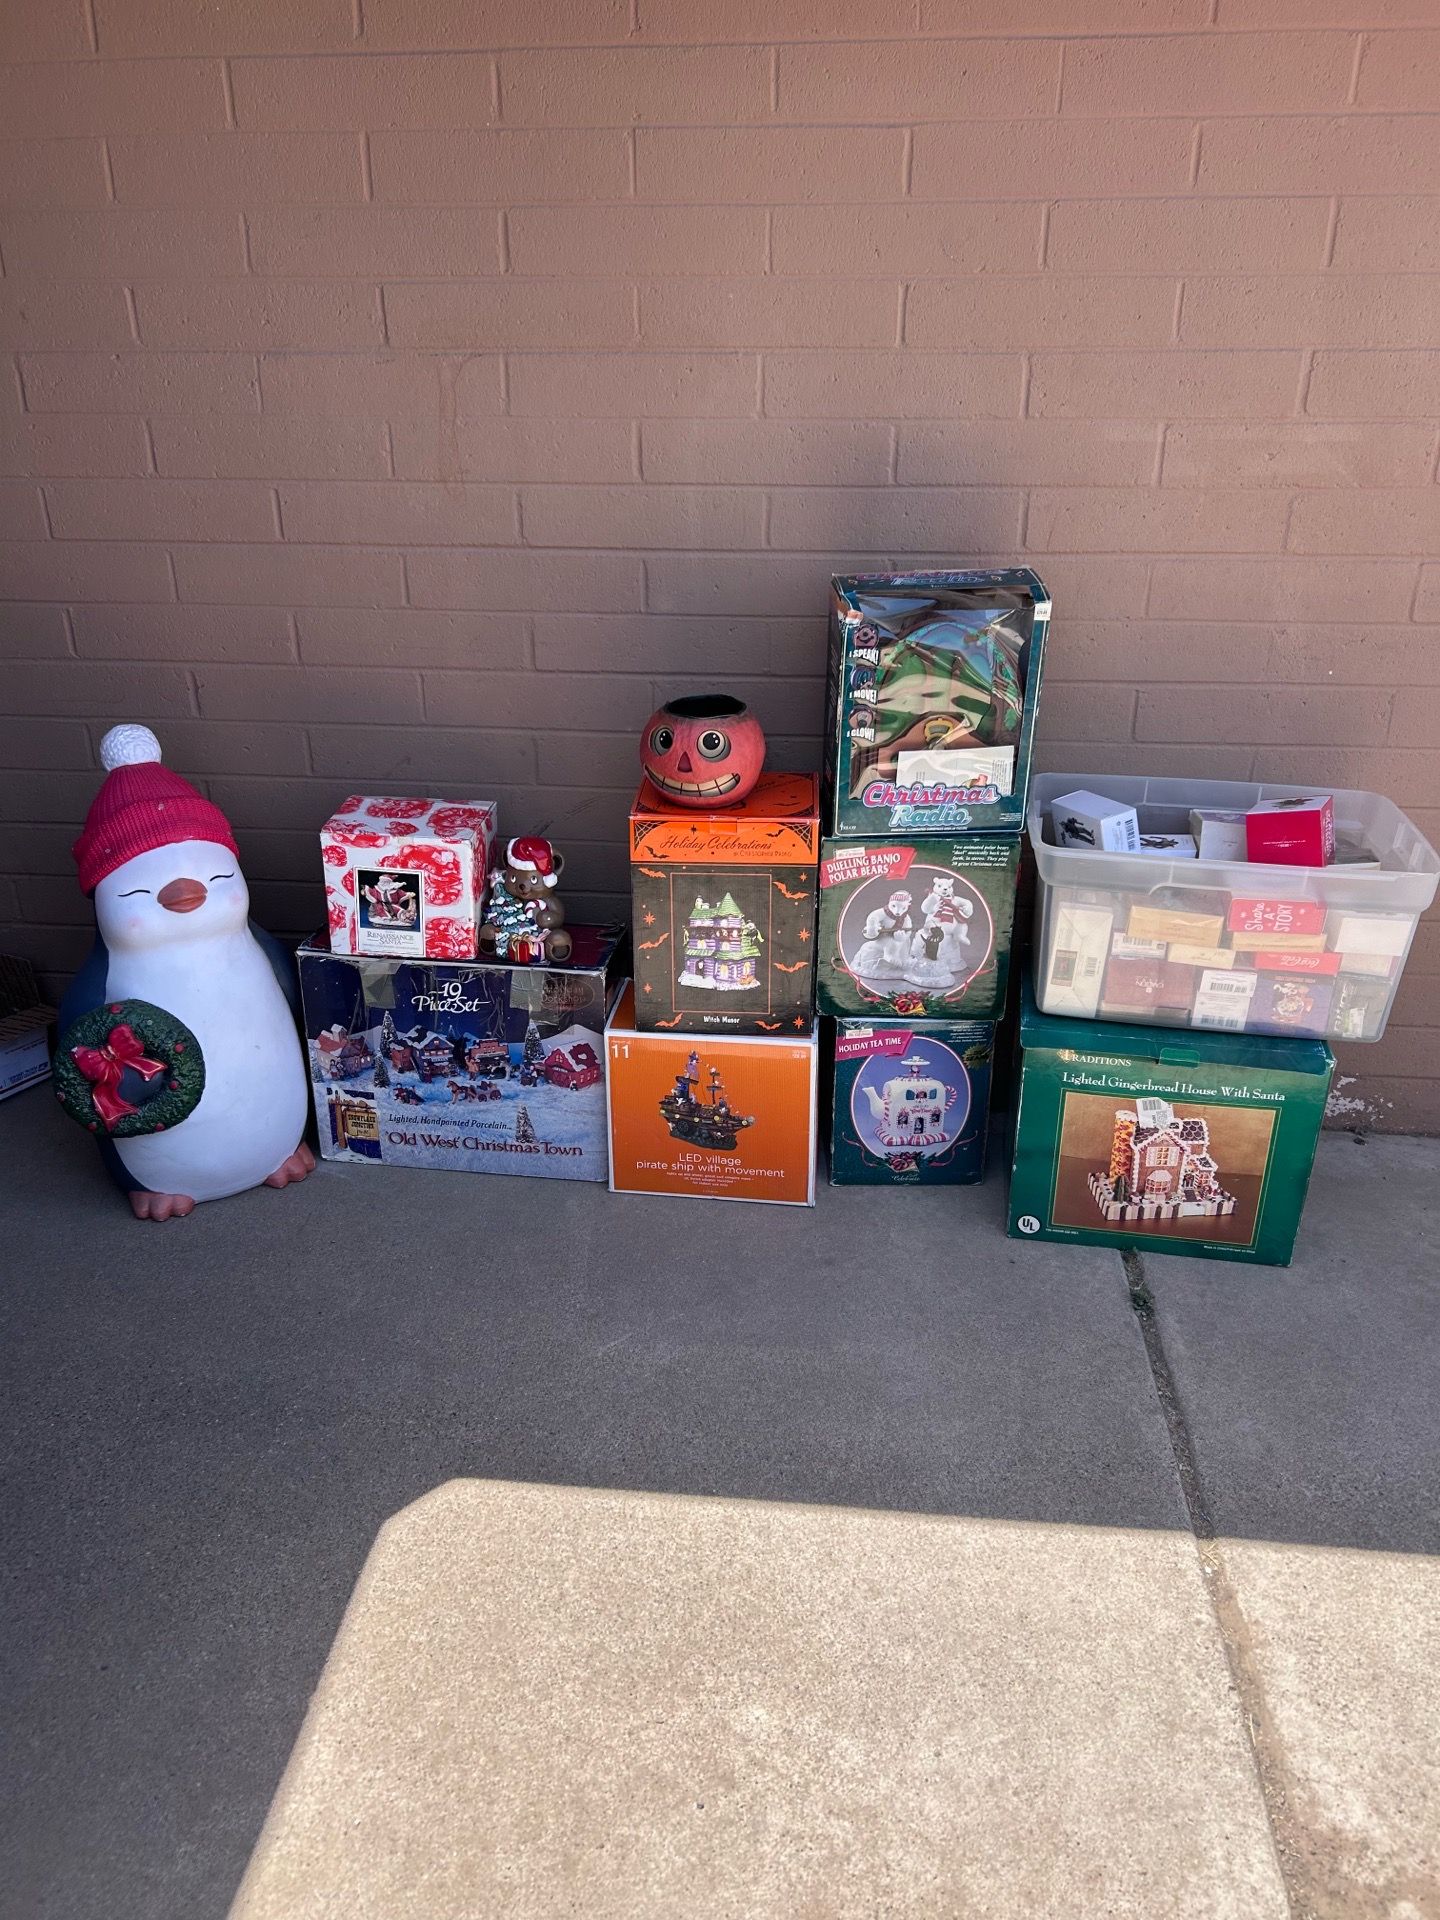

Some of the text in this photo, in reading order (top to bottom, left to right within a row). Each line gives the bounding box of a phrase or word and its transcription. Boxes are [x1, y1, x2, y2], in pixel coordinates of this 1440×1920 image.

[852, 648, 879, 666] SPEAK!
[853, 689, 877, 705] MOVE!
[851, 727, 875, 742] GLOW!
[863, 782, 1000, 807] Christmas
[888, 804, 973, 826] Radio
[660, 836, 772, 852] Holiday Celebrations
[826, 854, 870, 874] DUELLING
[870, 852, 901, 866] BANJO
[828, 864, 889, 884] POLAR BEARS
[1244, 902, 1265, 931] Share
[1273, 904, 1293, 932] STORY
[434, 982, 462, 1001] 19
[450, 996, 489, 1014] Set
[722, 1016, 740, 1024] Manor
[611, 1044, 629, 1058] 11
[838, 1037, 902, 1053] HOLIDAY TEA TIME
[1061, 1049, 1132, 1067] TRADITIONS
[1062, 1072, 1286, 1101] Lighted Gingerbread House With Santa
[388, 1113, 419, 1125] Lighted,
[420, 1117, 470, 1130] Handpainted
[462, 1136, 540, 1154] Christmas
[542, 1140, 584, 1156] Town
[679, 1153, 741, 1167] LED village
[636, 1161, 784, 1178] pirate ship with movement
